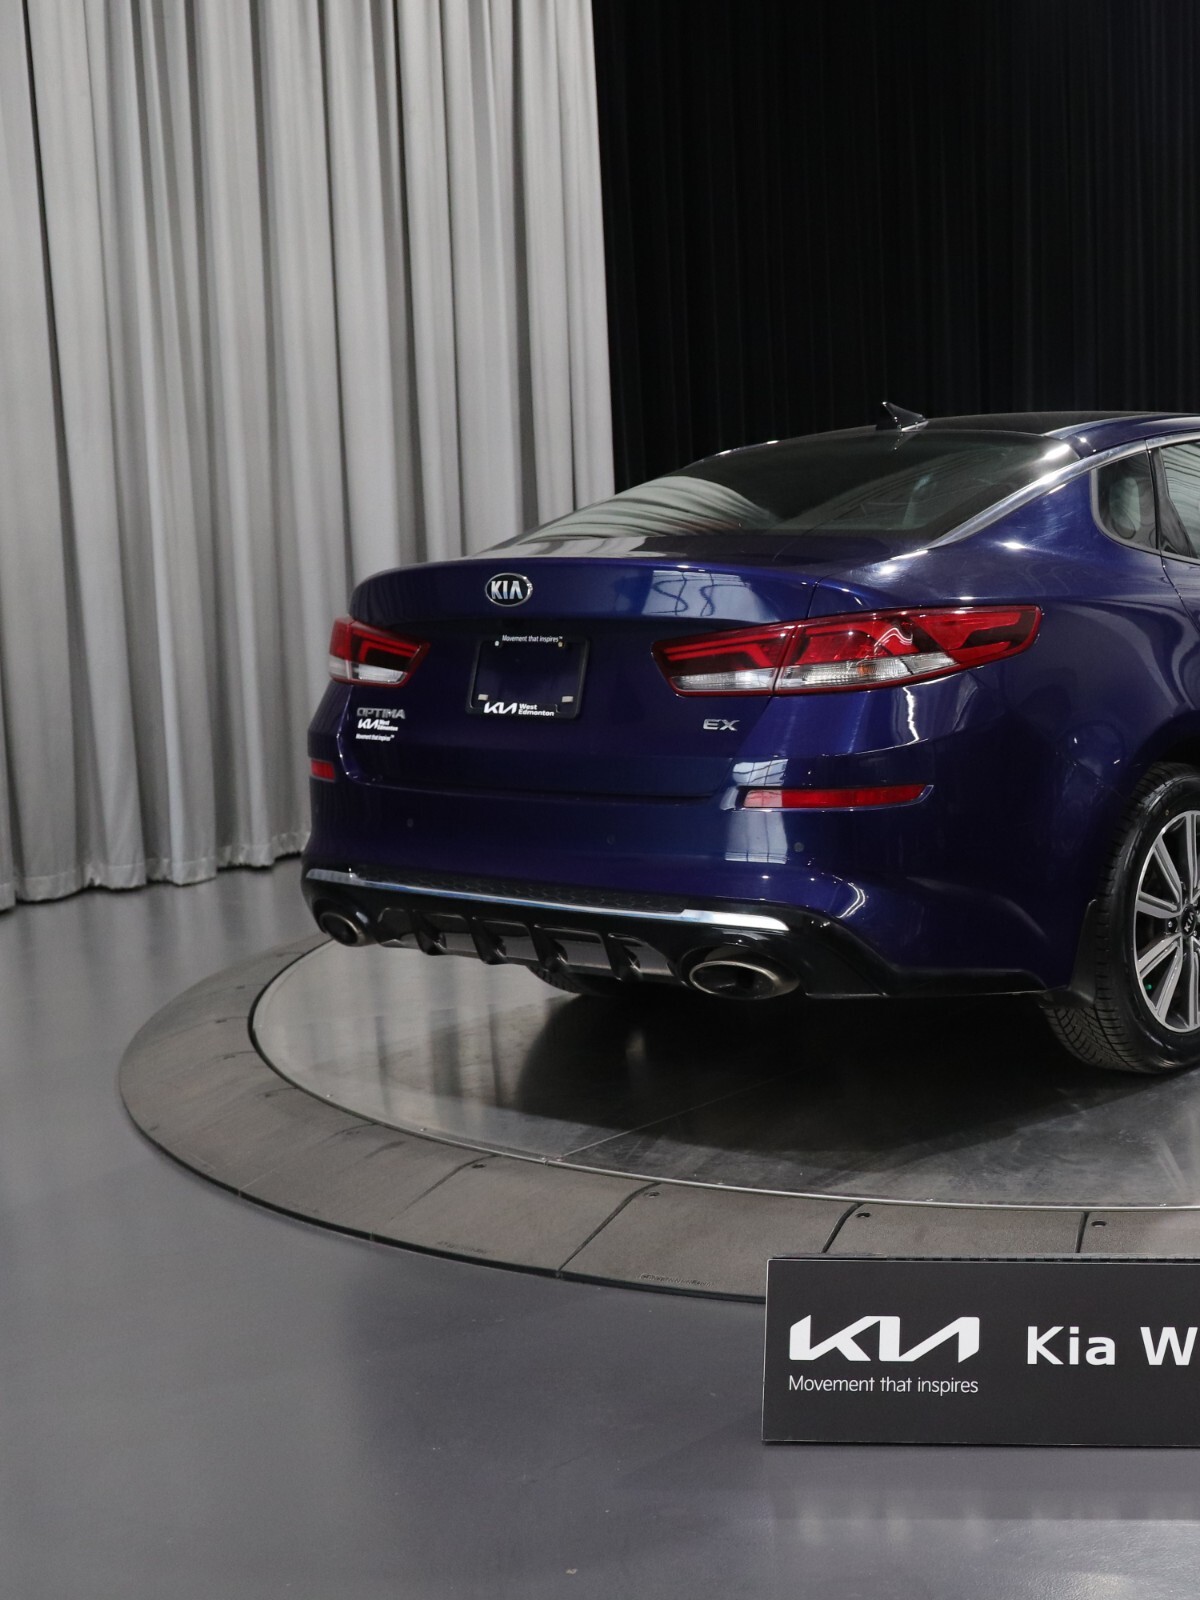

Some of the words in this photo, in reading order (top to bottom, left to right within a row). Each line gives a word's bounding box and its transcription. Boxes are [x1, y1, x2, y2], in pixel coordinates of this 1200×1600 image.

[491, 580, 523, 600] KIA
[502, 634, 527, 643] Movement
[528, 635, 539, 643] that
[356, 707, 406, 719] OPTIMA
[483, 701, 518, 715] KIA
[518, 709, 555, 717] Edmonton
[703, 718, 740, 732] EX
[1184, 912, 1194, 932] KIA
[789, 1315, 980, 1363] KIA
[1027, 1326, 1116, 1366] Kia
[789, 1375, 875, 1392] Movement
[879, 1376, 913, 1393] that
[917, 1377, 979, 1396] inspires
